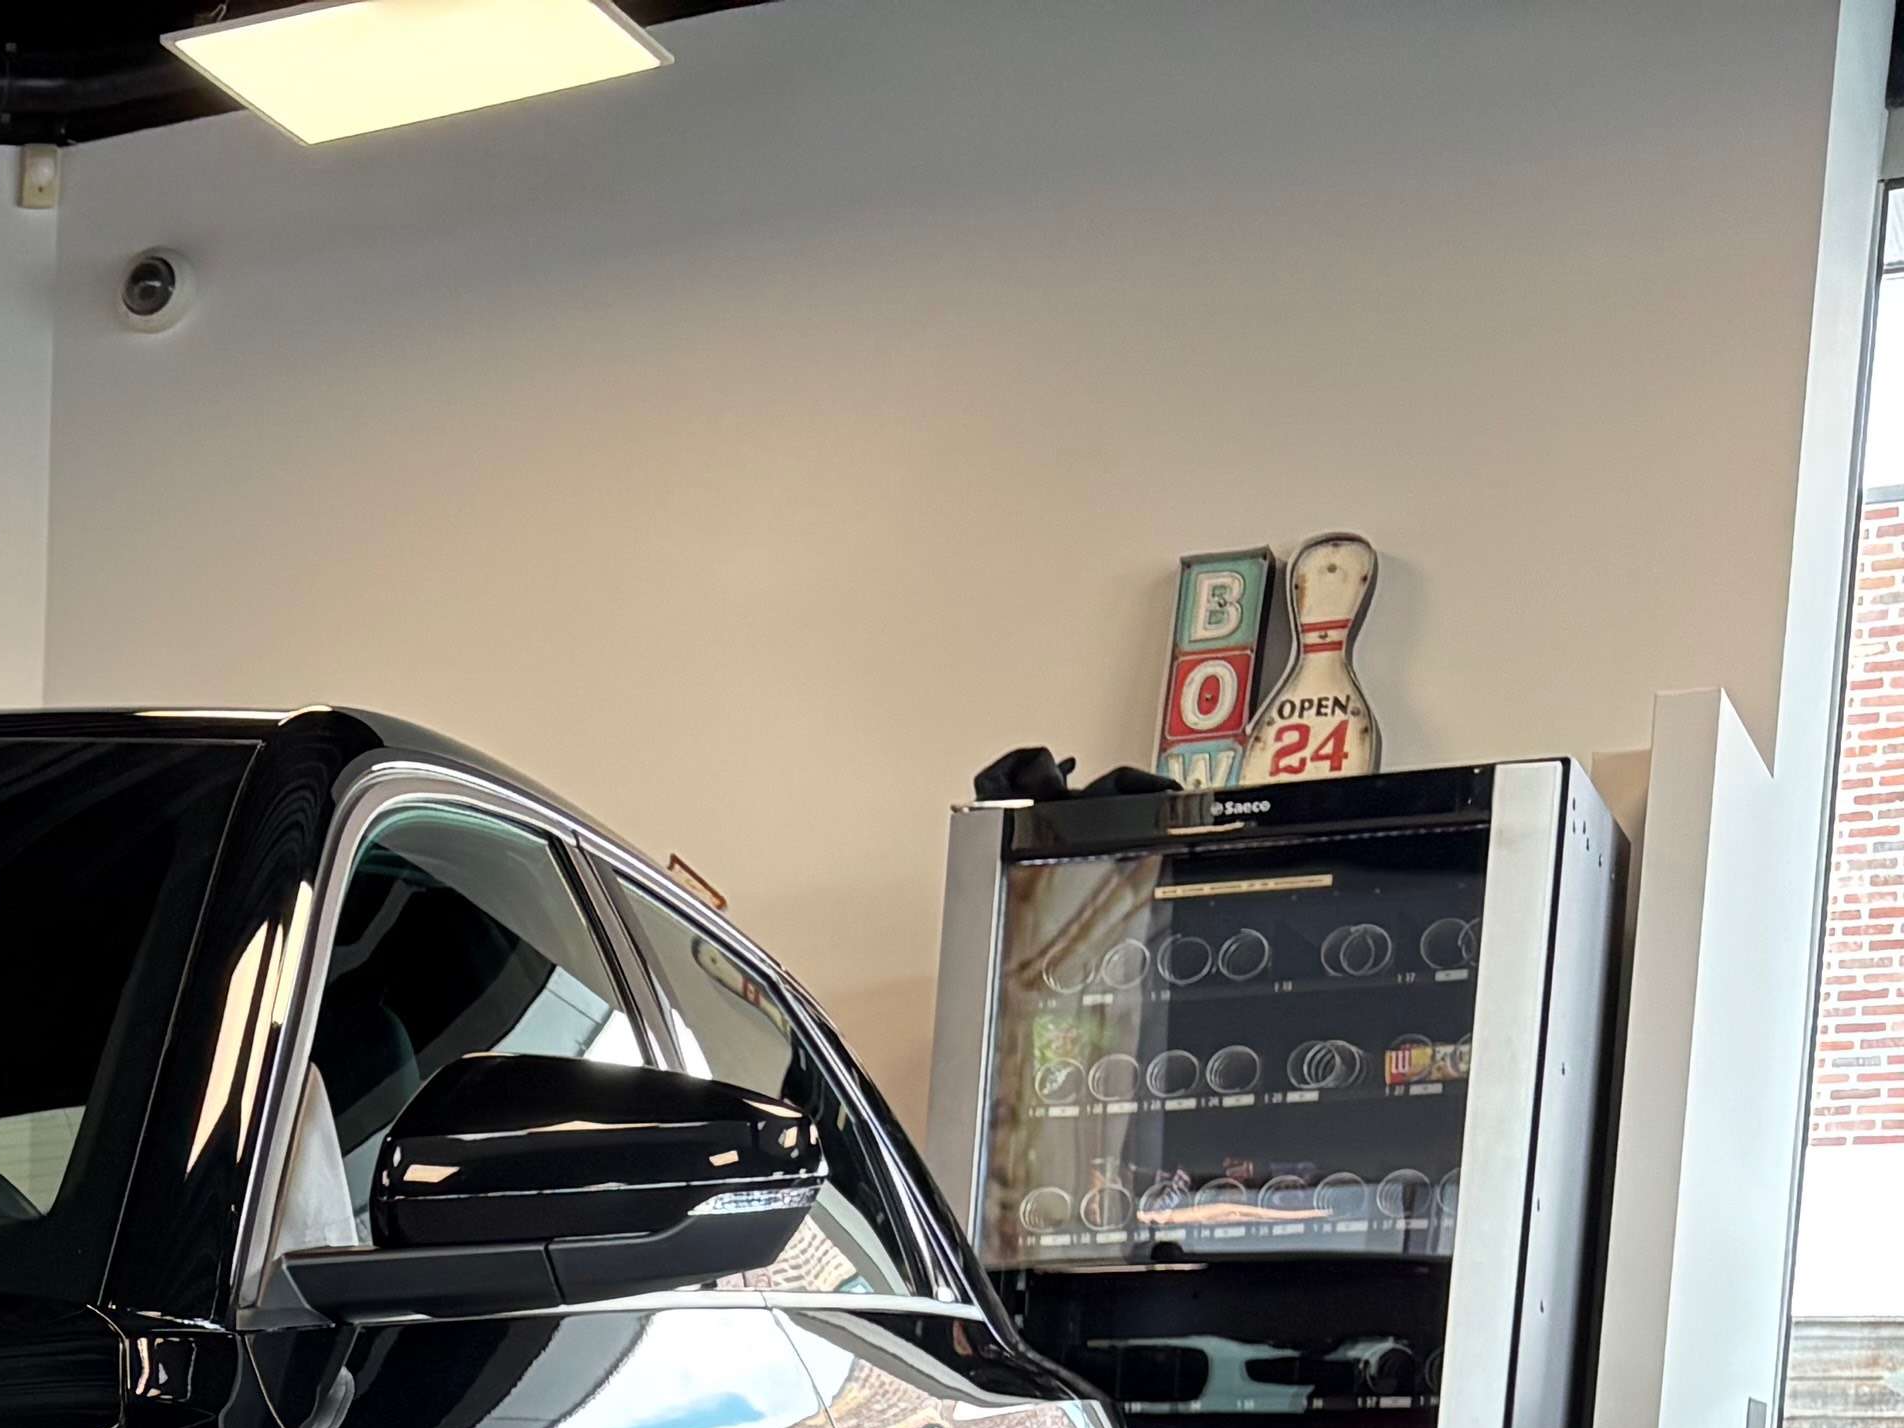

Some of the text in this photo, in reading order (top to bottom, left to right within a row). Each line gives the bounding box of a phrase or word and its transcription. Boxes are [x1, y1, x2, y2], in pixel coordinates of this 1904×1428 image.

[1277, 695, 1351, 720] OPEN
[1268, 719, 1350, 778] 24
[1224, 800, 1271, 816] Saeco
